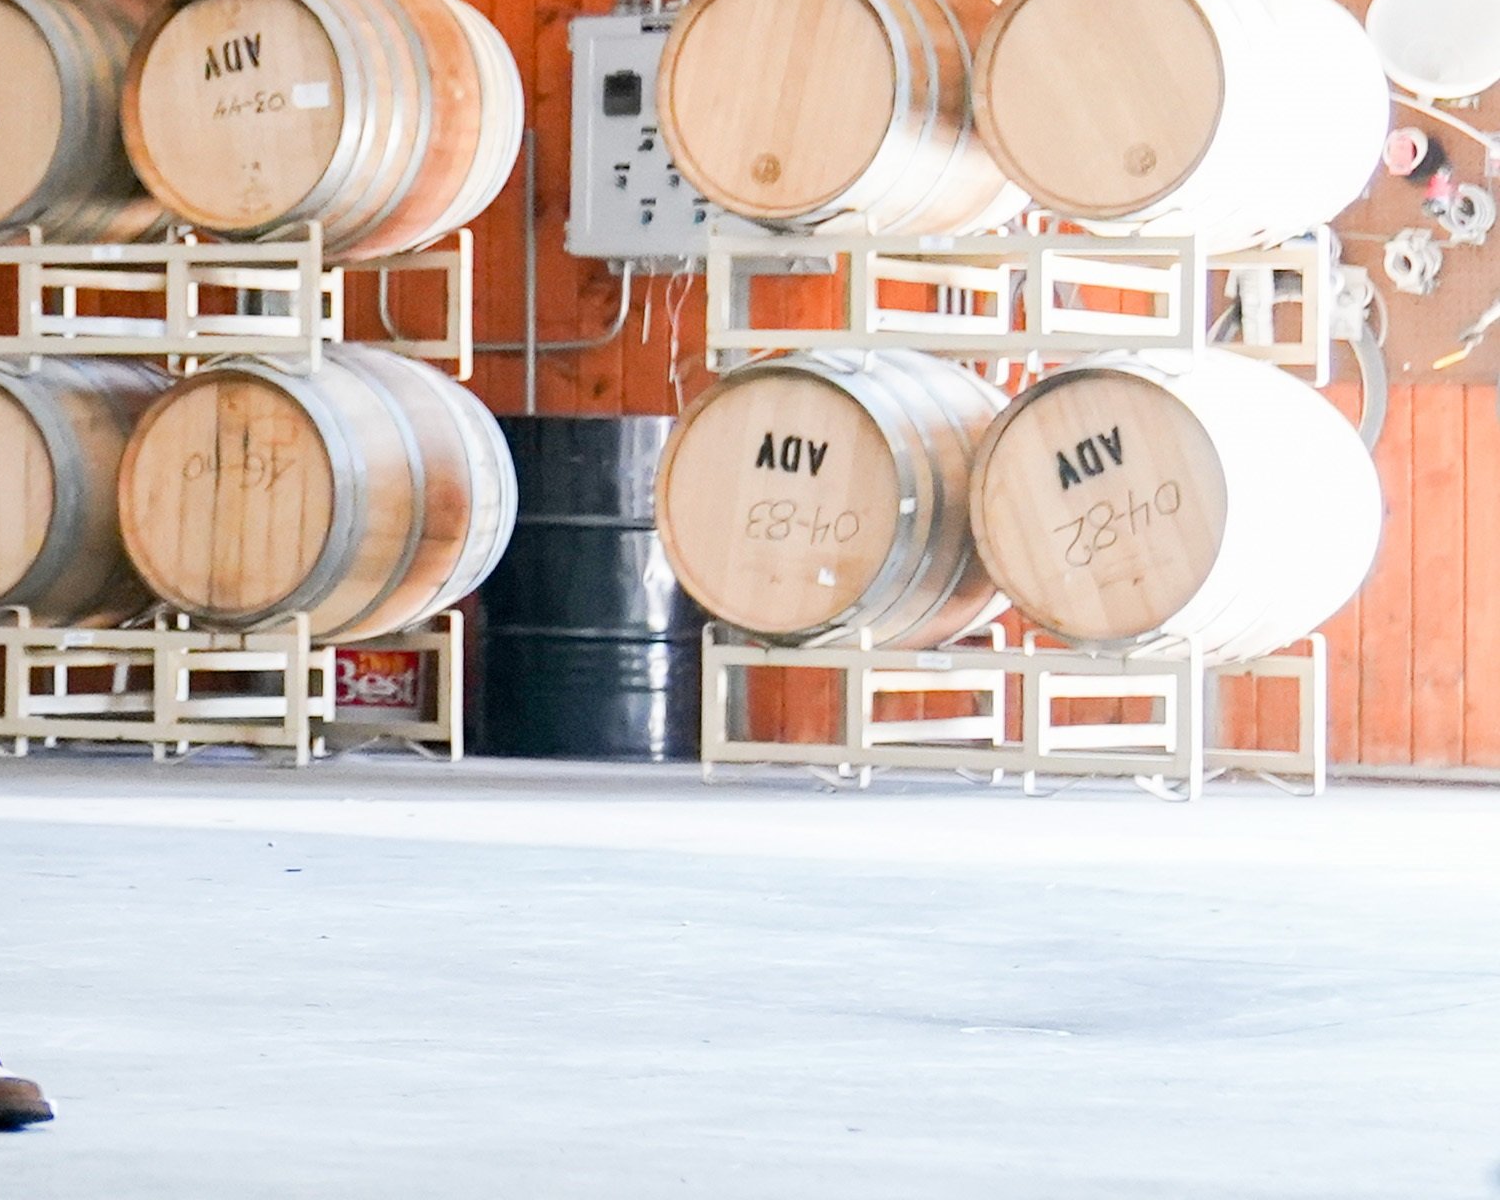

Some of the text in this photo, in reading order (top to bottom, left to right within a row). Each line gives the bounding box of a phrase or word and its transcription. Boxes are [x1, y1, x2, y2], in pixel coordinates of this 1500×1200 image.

[204, 31, 261, 81] ADV
[755, 431, 829, 477] ADV
[1055, 425, 1123, 491] ADV
[745, 500, 860, 546] 04-83
[1052, 480, 1181, 568] 04-82
